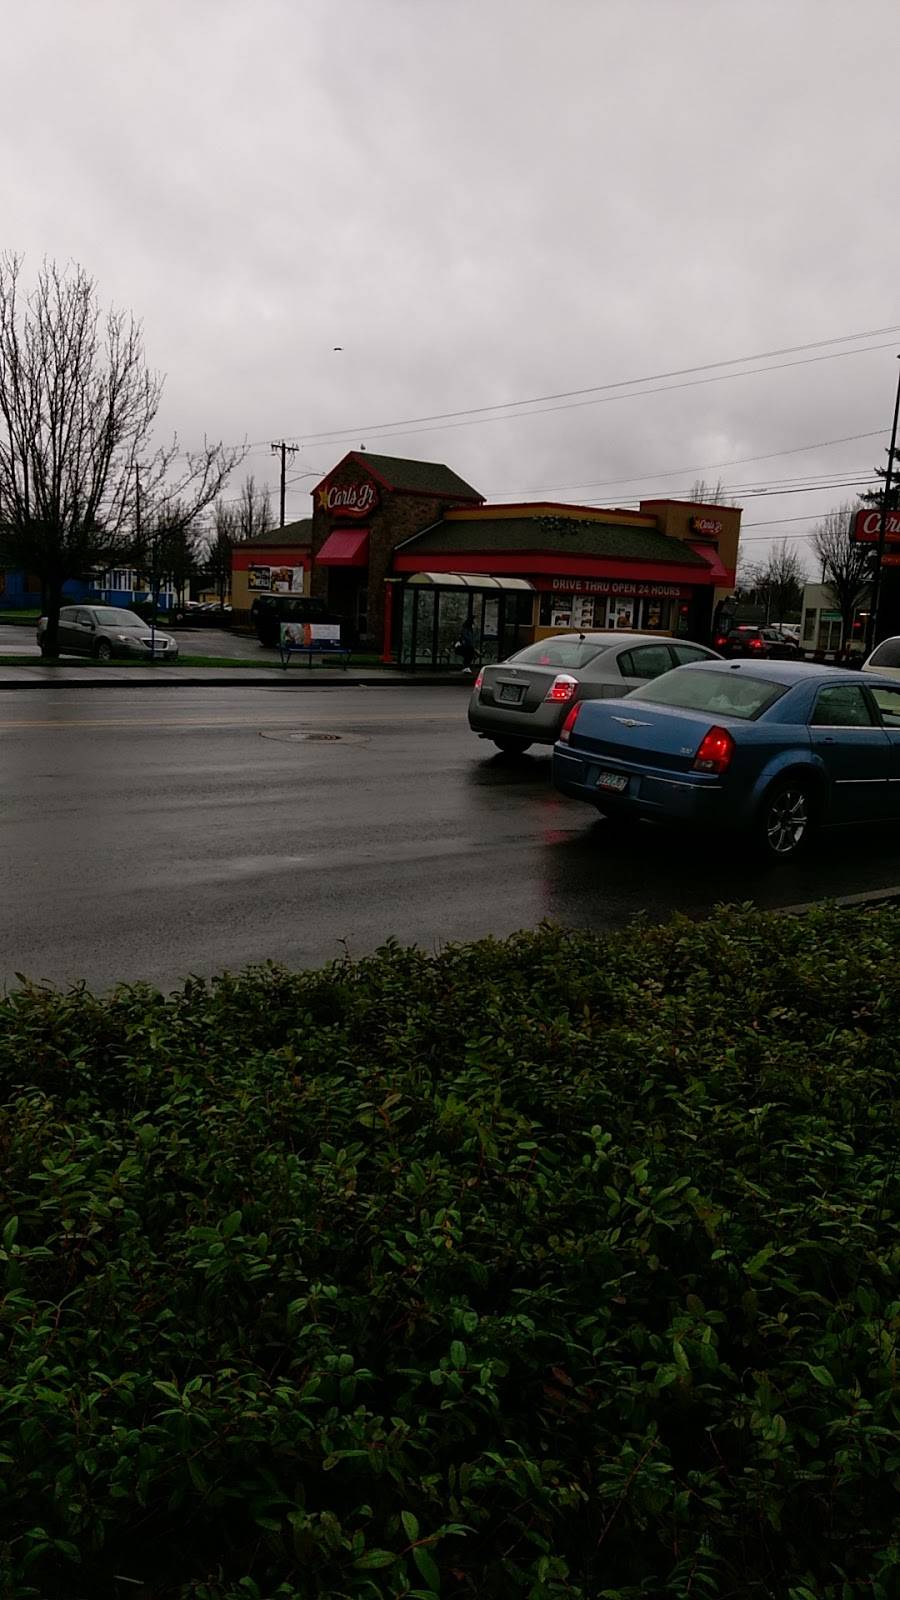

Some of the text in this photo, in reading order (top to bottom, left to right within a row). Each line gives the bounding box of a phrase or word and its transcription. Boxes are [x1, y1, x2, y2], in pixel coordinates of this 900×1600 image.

[552, 578, 681, 597] DRIVE THRU OPEN 24 HOURS
